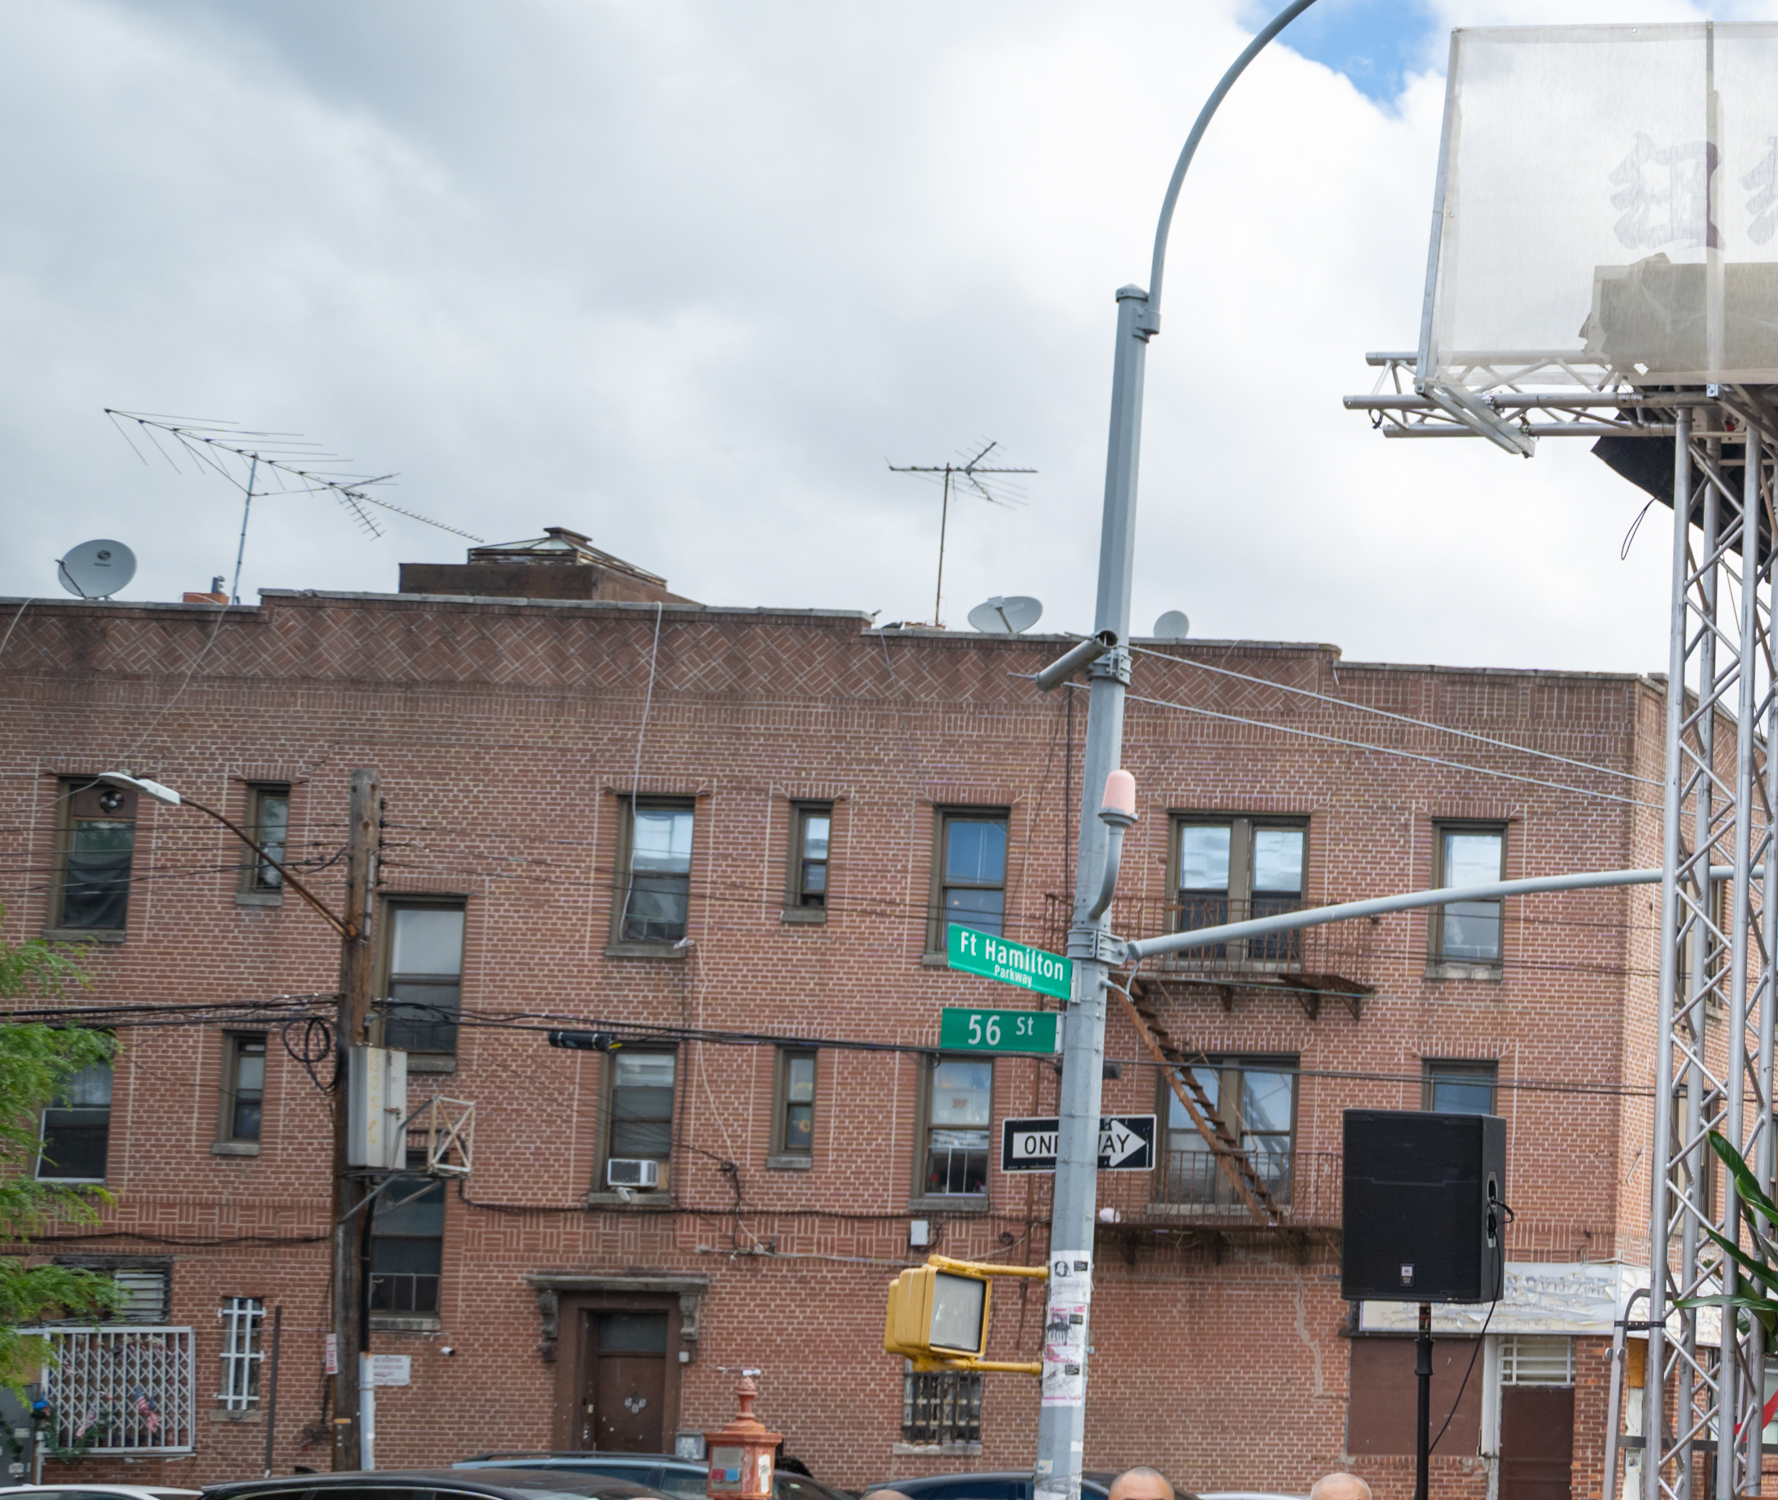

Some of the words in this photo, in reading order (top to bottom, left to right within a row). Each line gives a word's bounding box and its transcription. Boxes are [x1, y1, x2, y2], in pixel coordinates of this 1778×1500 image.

[960, 931, 977, 956] Ft
[985, 938, 1064, 981] Hamilton
[994, 964, 1033, 988] Parkway
[968, 1014, 1001, 1046] 56
[1016, 1016, 1034, 1036] St
[1099, 1133, 1131, 1154] AY
